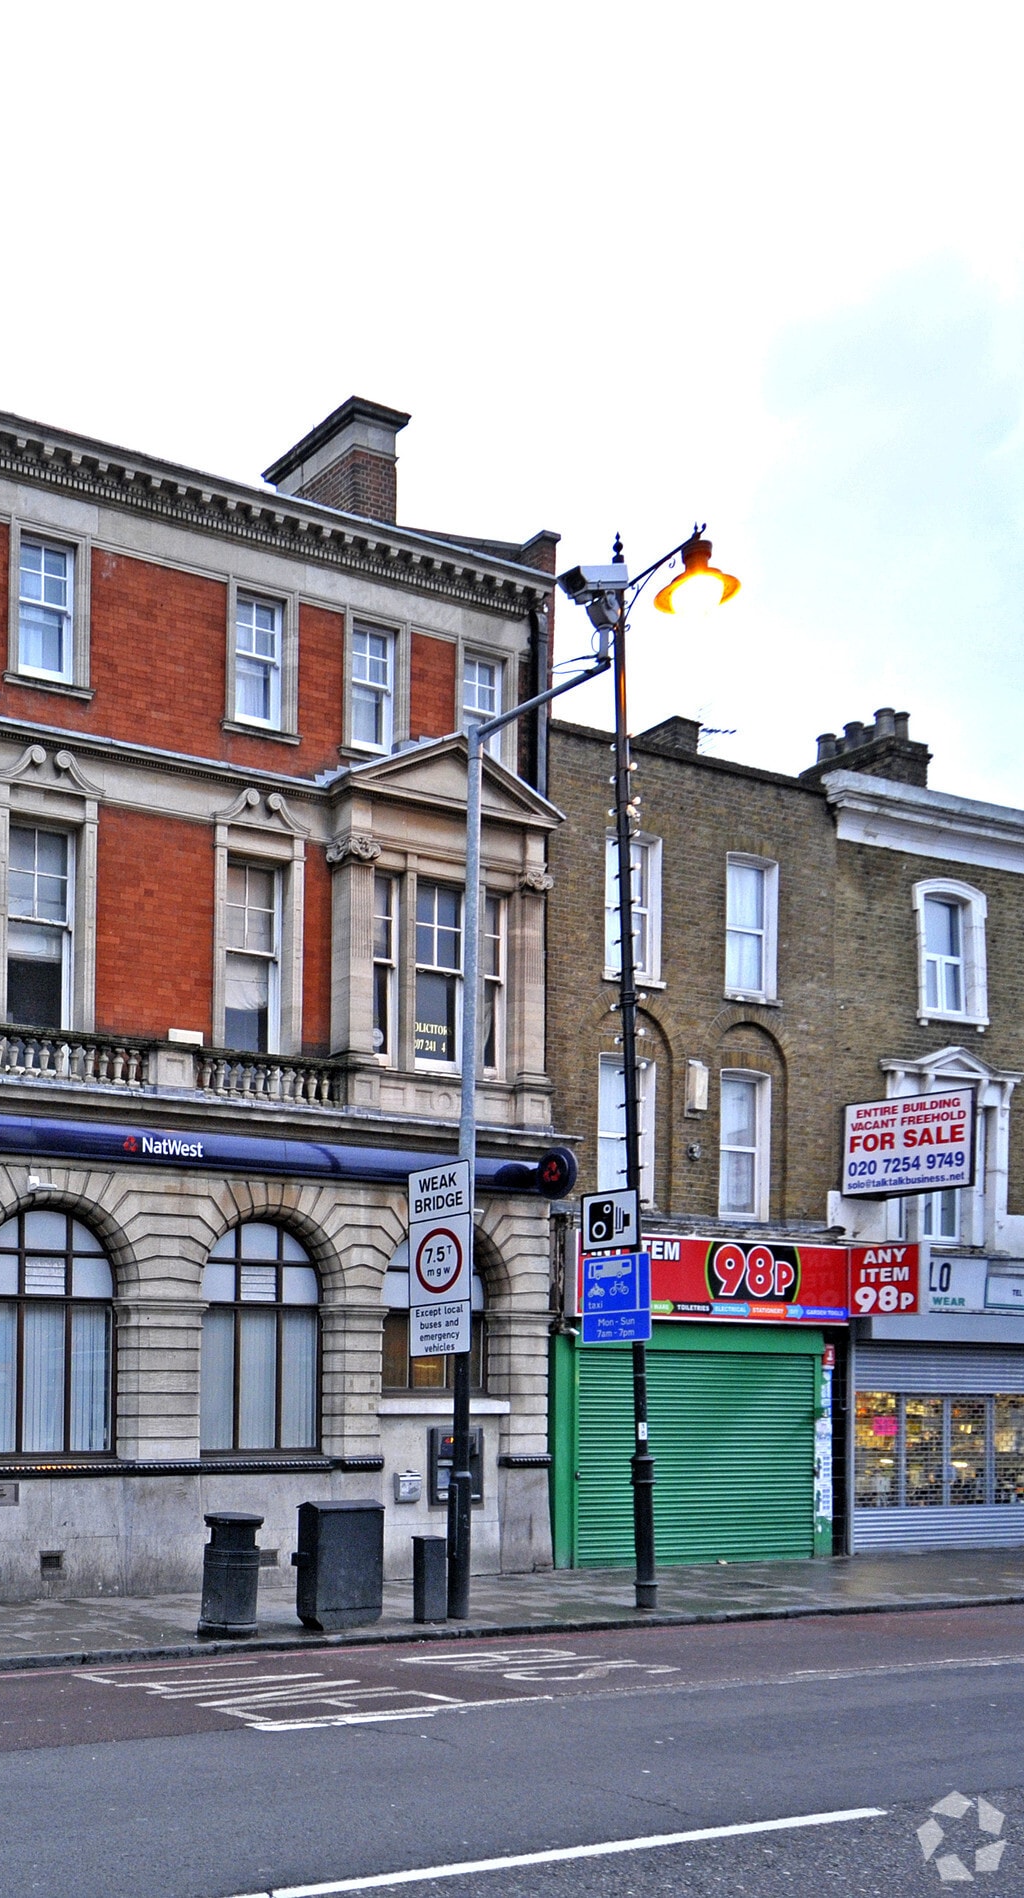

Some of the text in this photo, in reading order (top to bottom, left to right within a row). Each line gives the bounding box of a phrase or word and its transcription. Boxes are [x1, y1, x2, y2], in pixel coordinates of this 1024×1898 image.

[415, 1022, 452, 1036] OLICITORS
[856, 1097, 961, 1119] ENTIRE BUILDING
[851, 1110, 966, 1132] VACANT FREEHOLD
[849, 1124, 965, 1153] FOR SALE
[142, 1136, 204, 1158] NatWest
[848, 1151, 965, 1177] 020 7254 9749
[419, 1172, 457, 1193] WEAK
[847, 1172, 965, 1190] solo@talktalkbusiness.net
[415, 1190, 463, 1214] BRIDGE
[642, 1241, 680, 1260] TEM
[863, 1248, 907, 1265] ANY
[859, 1266, 910, 1284] ITEM
[588, 1301, 603, 1310] taxi
[677, 1304, 710, 1312] TOILETRIES
[932, 1297, 965, 1307] WEAR
[416, 1304, 463, 1318] Except local
[714, 1306, 746, 1314] ELECTRICAL
[752, 1307, 784, 1315] STATIONERY
[420, 1318, 459, 1330] buses and
[598, 1318, 614, 1327] Mon
[620, 1317, 635, 1325] Sun
[420, 1331, 460, 1341] emergency
[597, 1329, 612, 1338] 7am
[619, 1328, 635, 1338] 7pm
[424, 1343, 455, 1353] vehicles
